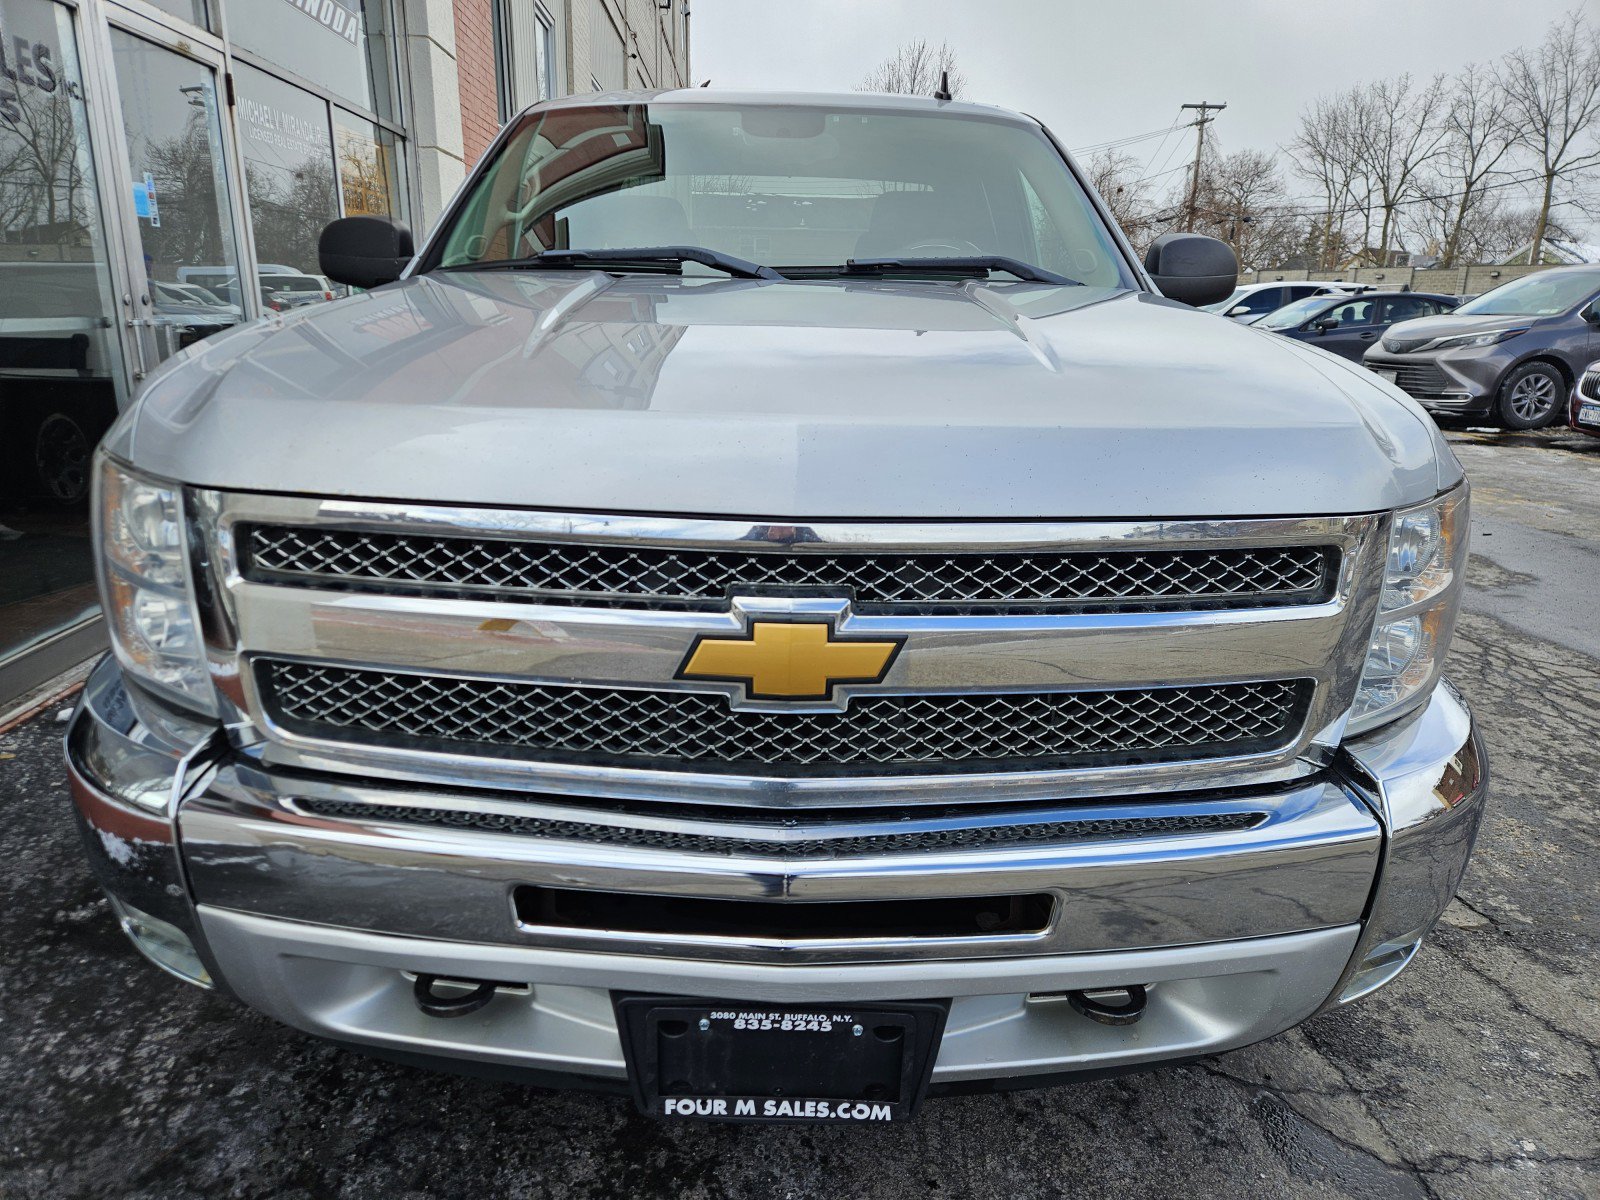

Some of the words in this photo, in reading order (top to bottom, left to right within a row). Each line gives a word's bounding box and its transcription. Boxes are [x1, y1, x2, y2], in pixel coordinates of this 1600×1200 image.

[285, 0, 358, 43] NODA
[237, 95, 274, 129] MICHAEL
[710, 1011, 736, 1020] 3080
[738, 1012, 766, 1020] MAIN
[768, 1013, 782, 1021] ST.
[784, 1013, 830, 1022] BUFFALO,
[832, 1014, 853, 1023] N.Y.
[733, 1019, 833, 1032] 835-8245
[664, 1098, 728, 1116] FOUR
[734, 1099, 756, 1117] M
[763, 1100, 892, 1122] SALES.COM
